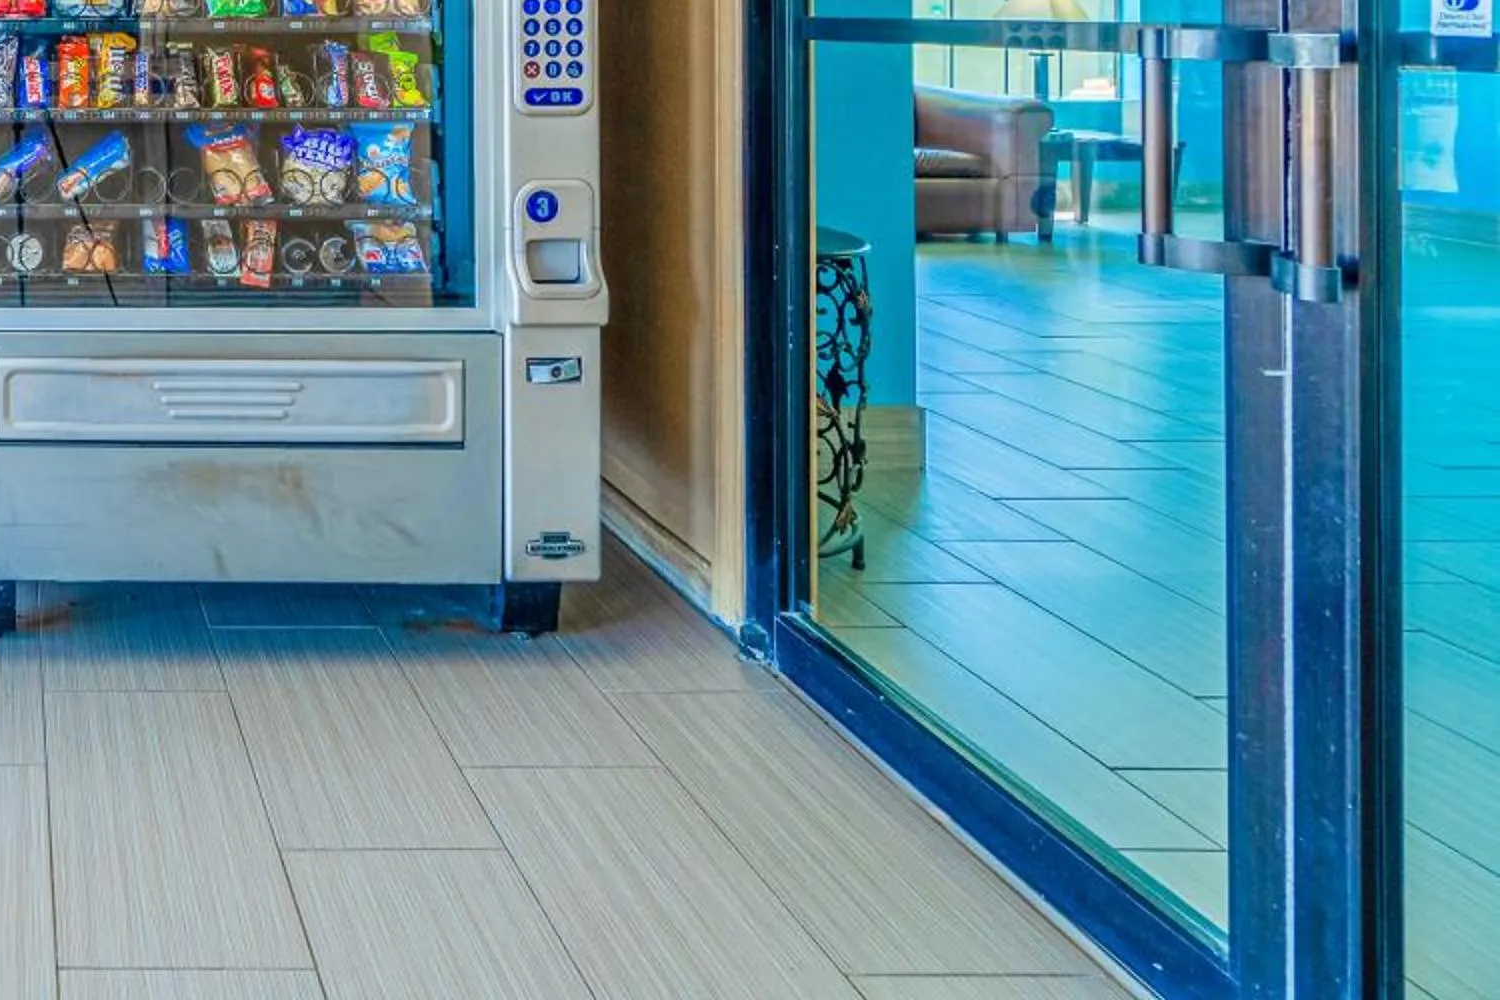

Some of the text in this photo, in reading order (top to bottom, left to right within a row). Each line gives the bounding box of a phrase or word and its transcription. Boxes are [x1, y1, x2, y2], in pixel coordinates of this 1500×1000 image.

[549, 22, 557, 33] 5
[570, 22, 579, 33] 6
[527, 43, 536, 55] 7
[551, 91, 573, 103] OK
[536, 197, 550, 217] 3
